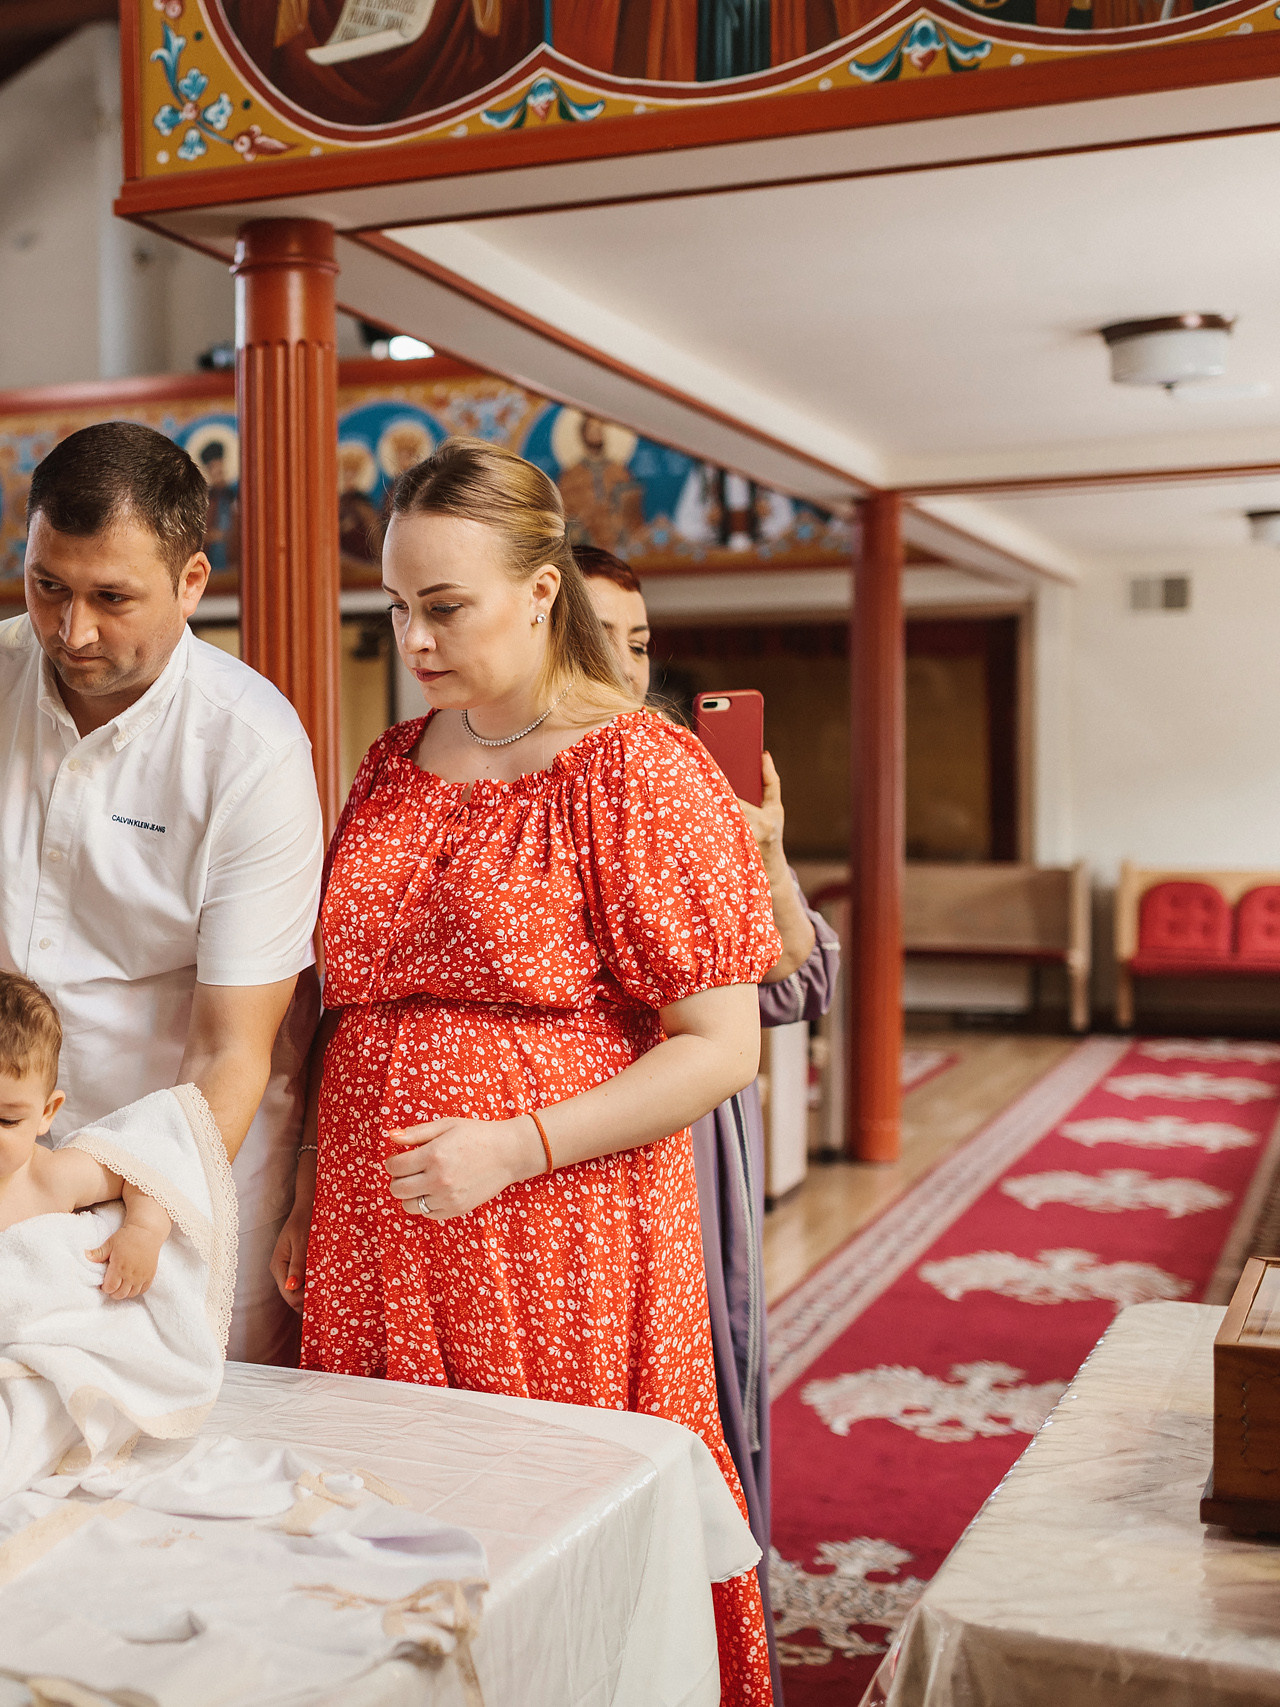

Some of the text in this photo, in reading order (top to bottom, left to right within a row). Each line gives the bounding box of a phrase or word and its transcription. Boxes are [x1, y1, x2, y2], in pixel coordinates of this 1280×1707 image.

[111, 814, 166, 833] CALVIN KLEIN JEANS
